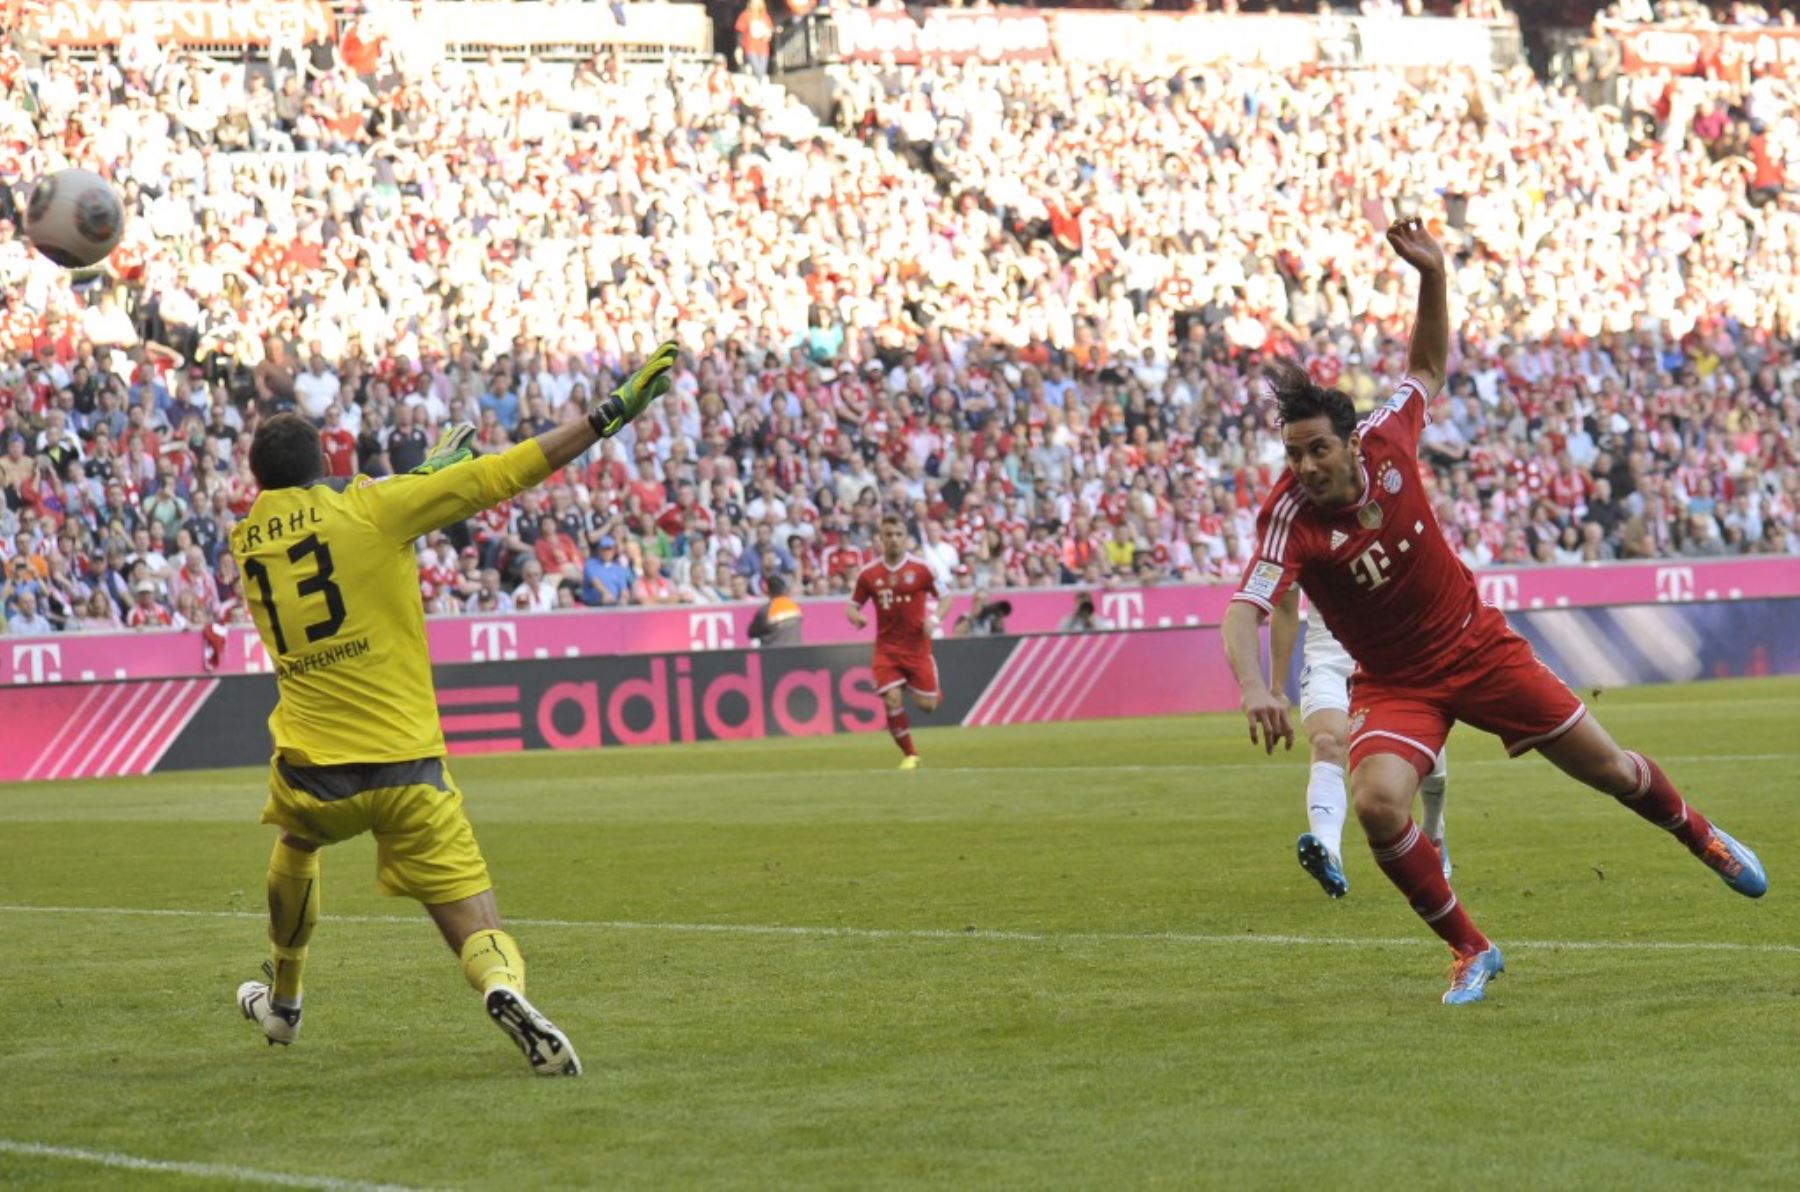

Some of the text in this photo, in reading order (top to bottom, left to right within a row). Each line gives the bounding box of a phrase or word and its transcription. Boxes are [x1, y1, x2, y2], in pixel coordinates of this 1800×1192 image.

[241, 507, 323, 553] RAHL
[244, 533, 347, 656] 13
[537, 653, 887, 749] adidas
